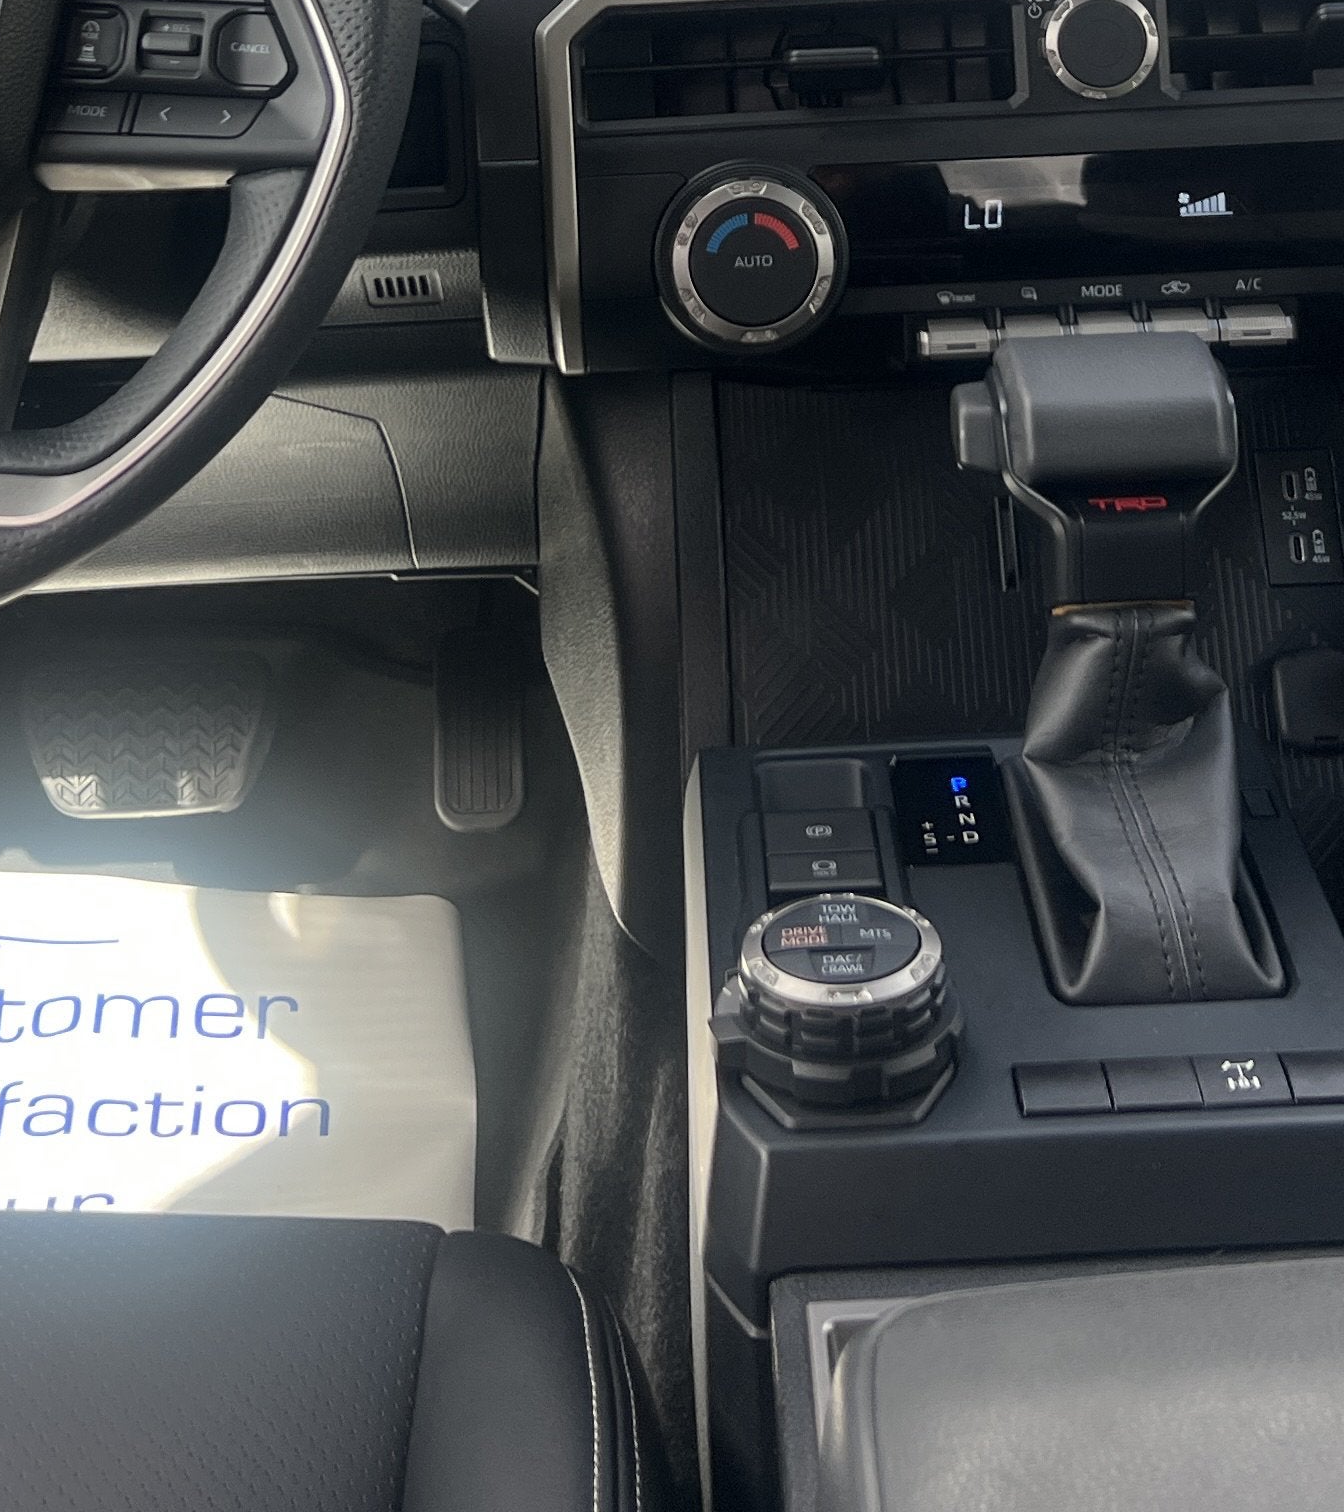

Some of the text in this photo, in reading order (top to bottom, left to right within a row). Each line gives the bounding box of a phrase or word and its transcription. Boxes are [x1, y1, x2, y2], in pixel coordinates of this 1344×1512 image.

[231, 41, 271, 55] CANCEL
[67, 104, 107, 118] MODE
[964, 199, 1004, 231] LO
[734, 254, 774, 268] AUTO
[1081, 283, 1123, 298] MODE
[1235, 278, 1262, 292] A/C
[1088, 495, 1168, 512] TRD
[950, 776, 968, 792] P
[955, 794, 972, 808] R
[959, 812, 976, 826] N
[923, 831, 937, 847] S
[962, 830, 980, 844] D
[821, 903, 857, 914] TOW
[818, 912, 859, 923] HAUL
[781, 925, 826, 937] DRIVE
[859, 928, 892, 939] MTS
[781, 935, 829, 947] MODE
[821, 963, 865, 974] CRAWL
